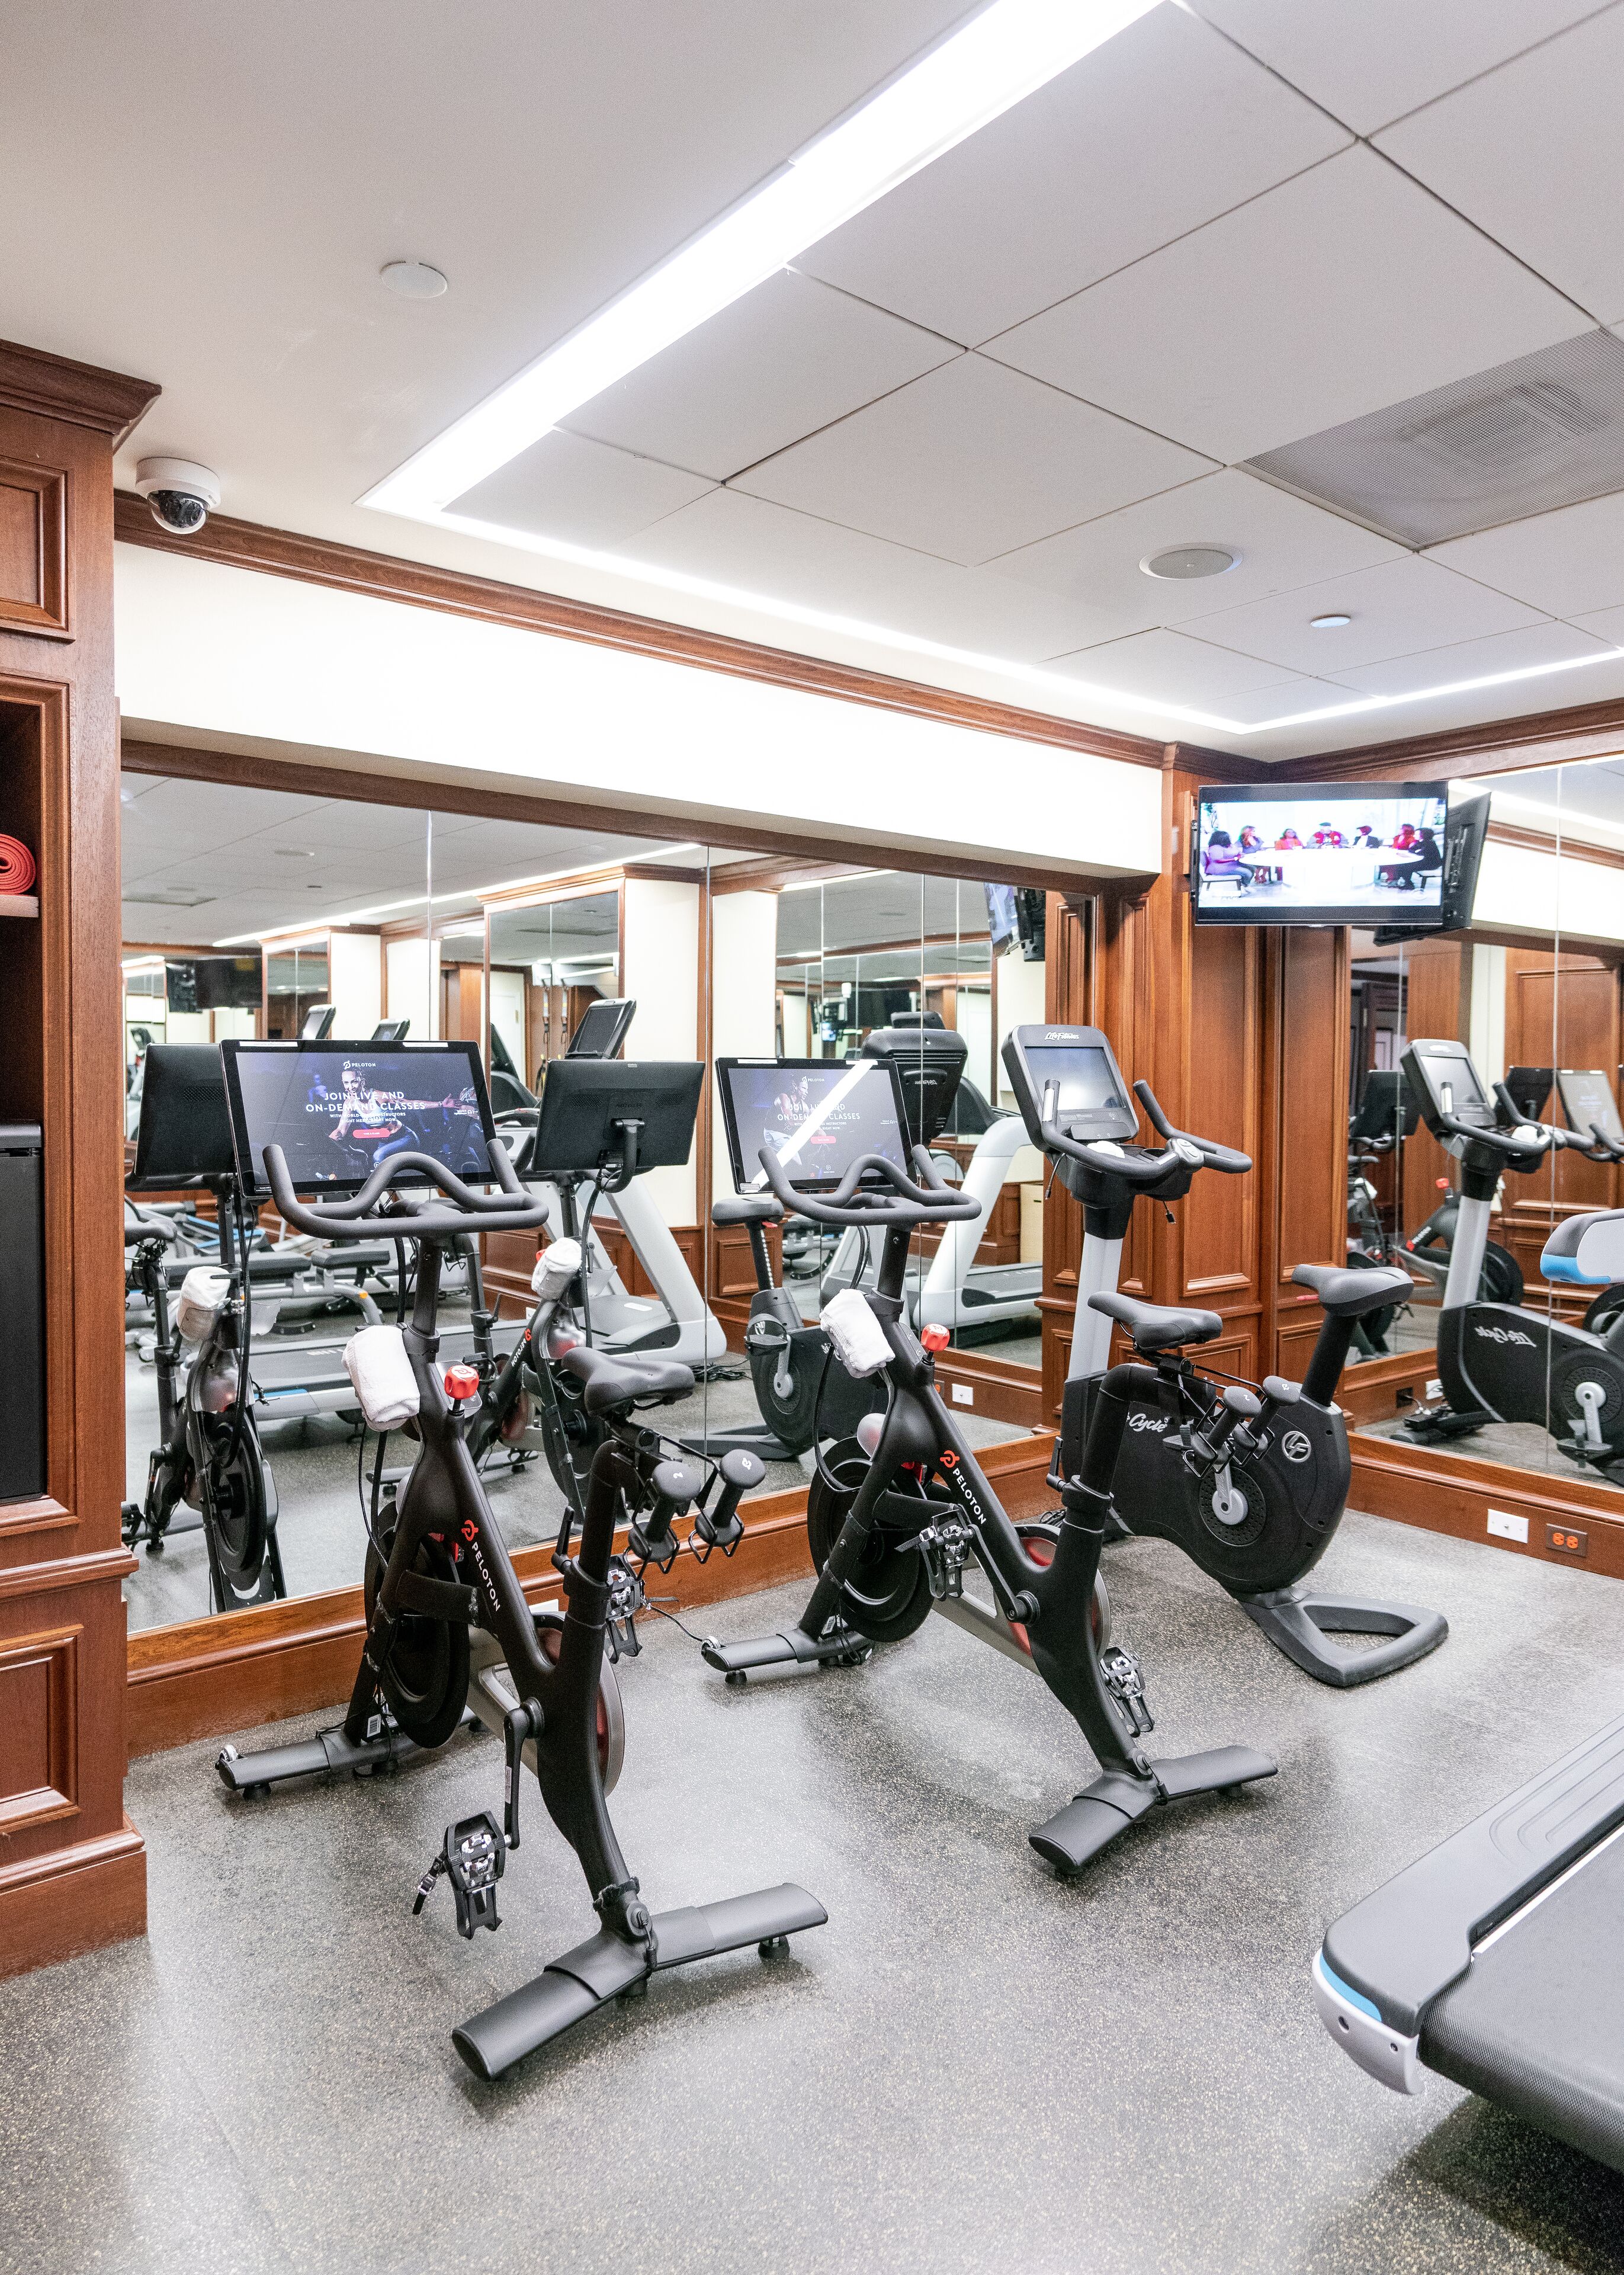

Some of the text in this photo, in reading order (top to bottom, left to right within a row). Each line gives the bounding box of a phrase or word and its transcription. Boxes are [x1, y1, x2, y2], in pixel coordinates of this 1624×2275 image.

[306, 1102, 426, 1112] ON-DEMAND CLASSES
[324, 1092, 351, 1101] JOIN
[355, 1091, 378, 1100] LIVE
[952, 1467, 987, 1525] PELOTON
[471, 1542, 500, 1612] PELOTON
